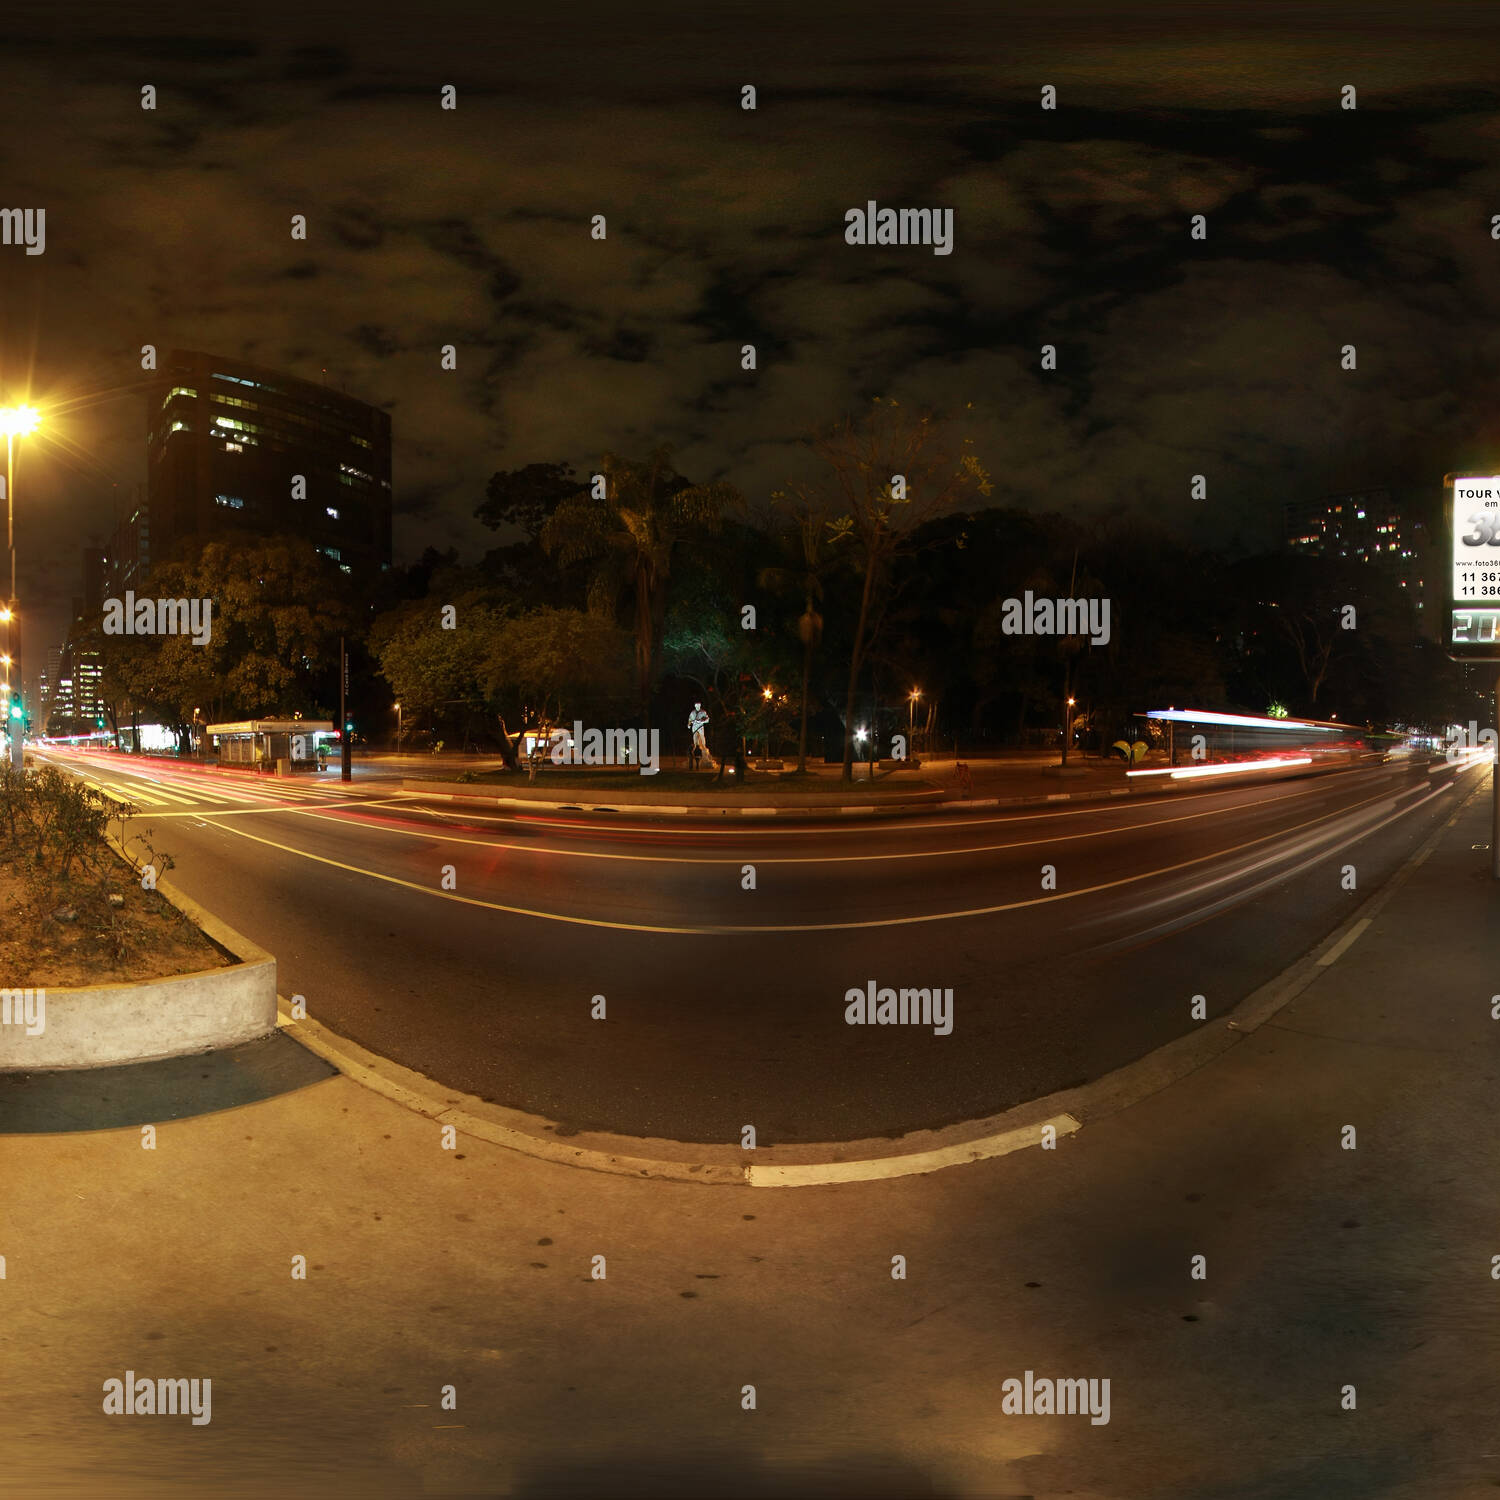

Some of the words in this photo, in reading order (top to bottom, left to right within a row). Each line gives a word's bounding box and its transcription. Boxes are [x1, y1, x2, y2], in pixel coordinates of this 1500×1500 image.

[1458, 489, 1492, 499] TOUR
[1461, 572, 1475, 582] 11
[1461, 586, 1475, 595] 11
